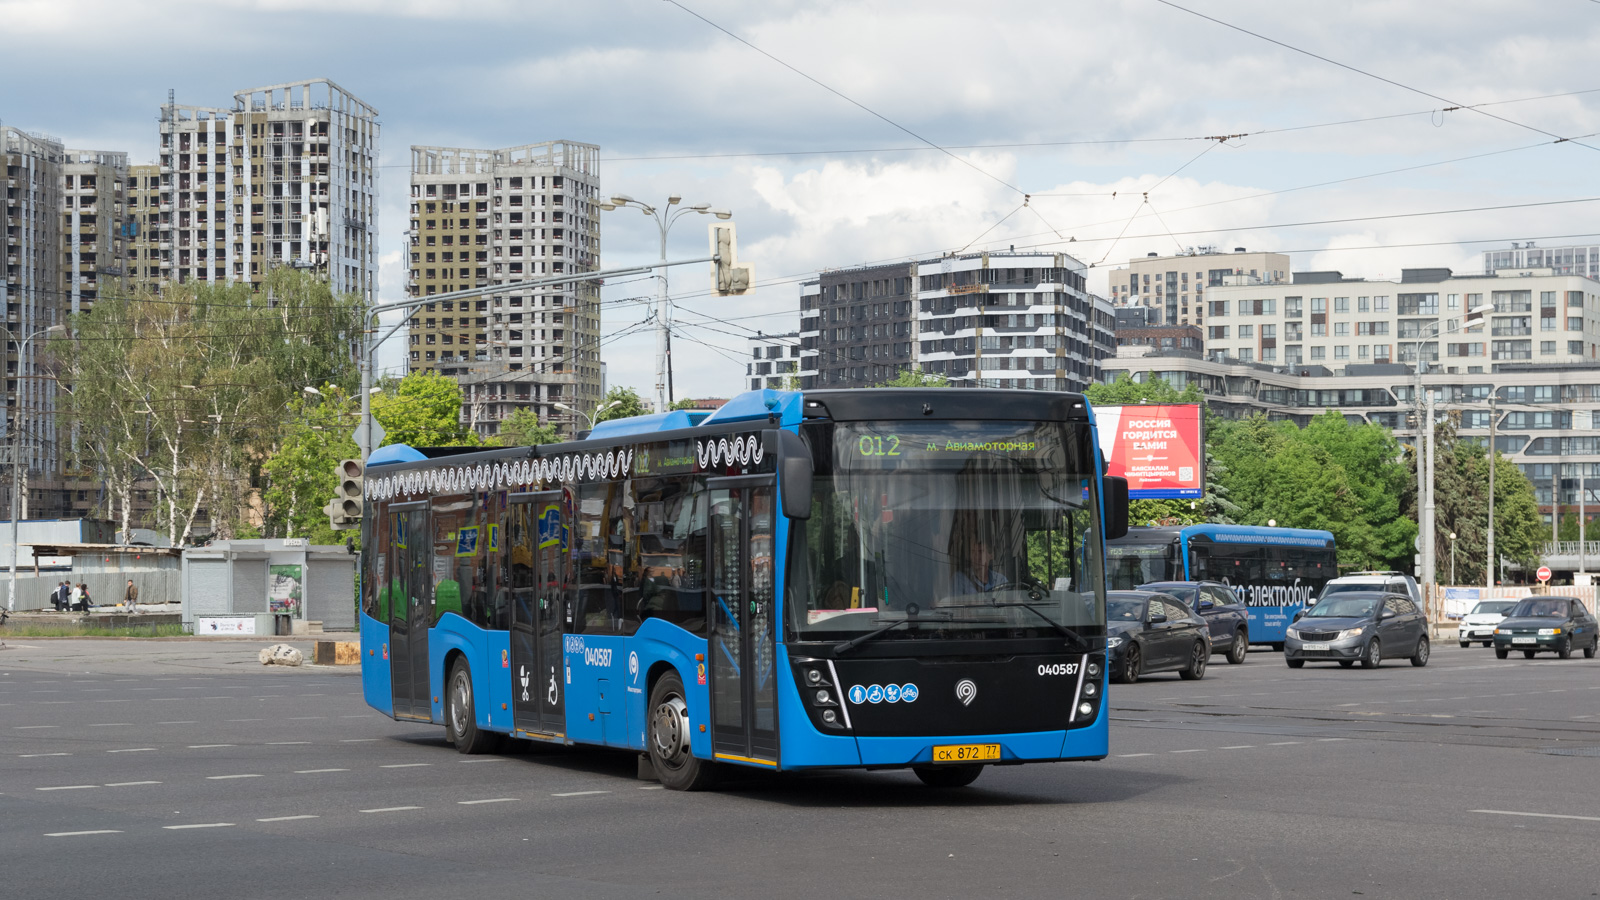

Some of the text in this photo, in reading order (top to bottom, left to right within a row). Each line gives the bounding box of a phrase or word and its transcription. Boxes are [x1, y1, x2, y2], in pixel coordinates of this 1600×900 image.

[1128, 419, 1171, 429] РОССИЯ
[1122, 430, 1177, 440] ГОРДИТСЯ
[859, 435, 901, 456] 012
[926, 440, 1035, 452] м. Авиамоторная
[1133, 441, 1167, 450] ВАМИ!
[1247, 577, 1314, 615] электробус
[584, 647, 612, 667] 040587
[1037, 663, 1079, 676] 040587
[938, 745, 997, 759] СК 872 77
